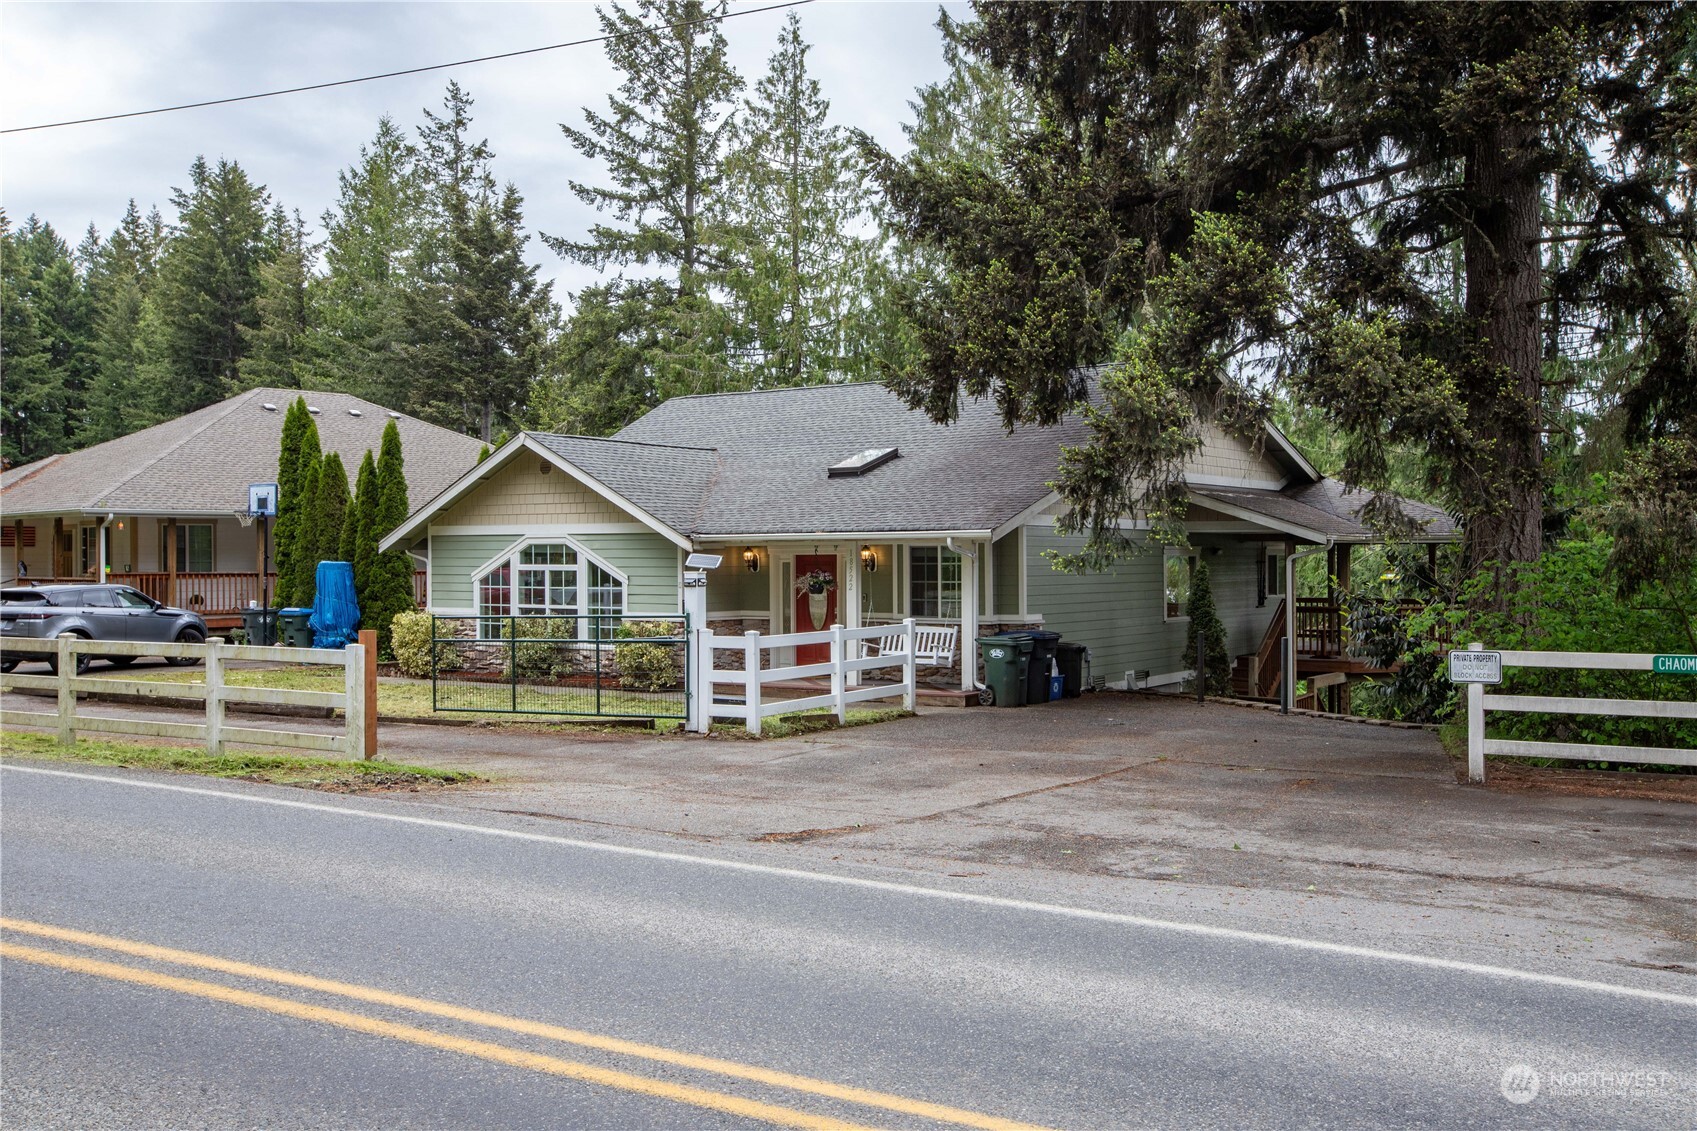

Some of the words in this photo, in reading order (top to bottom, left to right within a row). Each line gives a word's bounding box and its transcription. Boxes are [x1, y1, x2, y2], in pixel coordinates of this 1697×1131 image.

[1453, 654, 1471, 662] PRIVATE
[1473, 654, 1497, 662] PROPERTY
[1659, 658, 1697, 670] CHAOM
